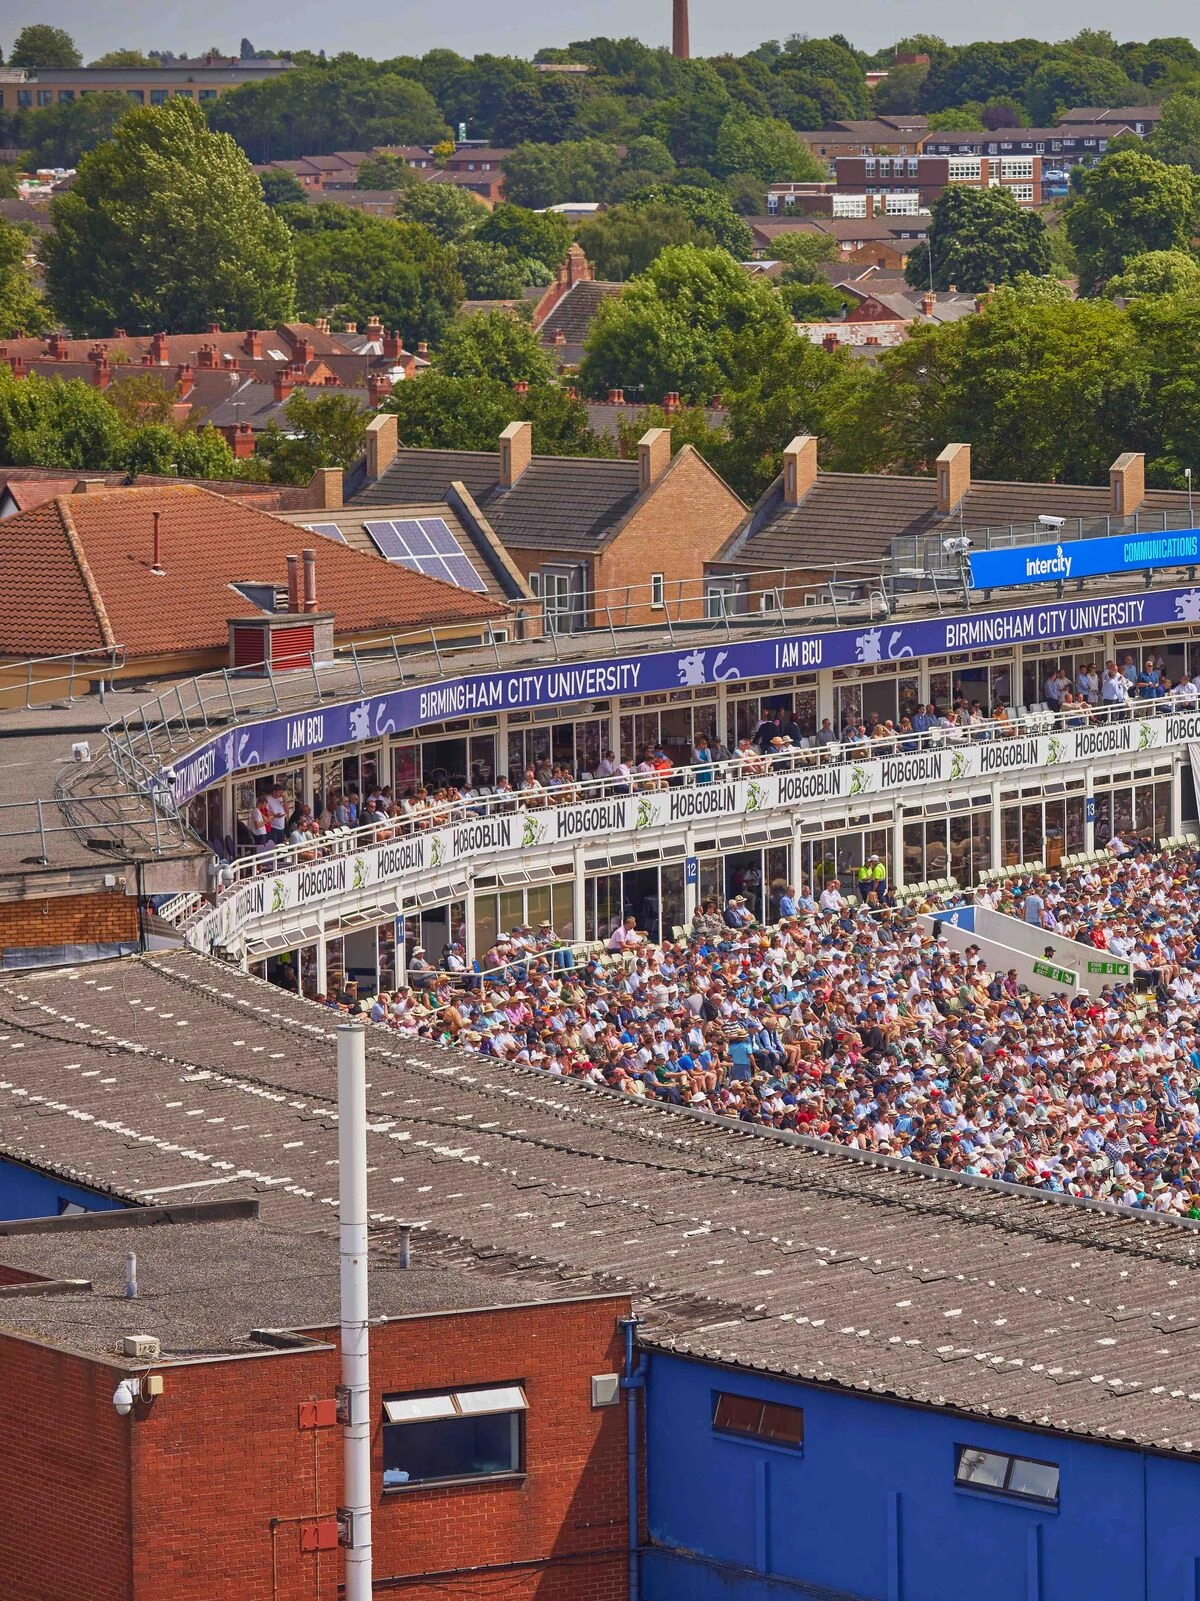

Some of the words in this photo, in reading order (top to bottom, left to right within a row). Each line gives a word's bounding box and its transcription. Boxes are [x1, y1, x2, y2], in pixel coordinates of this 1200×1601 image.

[1026, 546, 1072, 576] intercity
[1124, 537, 1198, 562] COMMUNICATIONS
[946, 613, 1034, 647] BIRMINGHAM
[1038, 609, 1067, 635] CITY
[1070, 600, 1145, 631] UNIVERSITY
[775, 645, 779, 668] I
[781, 642, 799, 667] AM
[802, 640, 822, 665] BCU
[420, 680, 502, 718] BIRMINGHAM
[508, 675, 544, 703] CITY
[548, 663, 640, 698] UNIVERSITY
[292, 721, 305, 749] AM
[307, 715, 324, 745] BCU
[1075, 726, 1130, 757] HOBGOBLIN
[882, 755, 941, 787] HOBGOBLIN
[980, 740, 1038, 771] HOBGOBLIN
[778, 770, 840, 803] HOBGOBLIN
[671, 786, 735, 820] HOBGOBLIN
[1087, 804, 1094, 815] 13
[557, 803, 625, 838] HOBGOBLIN
[454, 820, 510, 857] HOBGOBLIN
[378, 840, 423, 880] HOBGOBLIN
[687, 863, 696, 876] 12
[298, 861, 346, 901] HOBGOBLIN
[398, 922, 403, 936] 11
